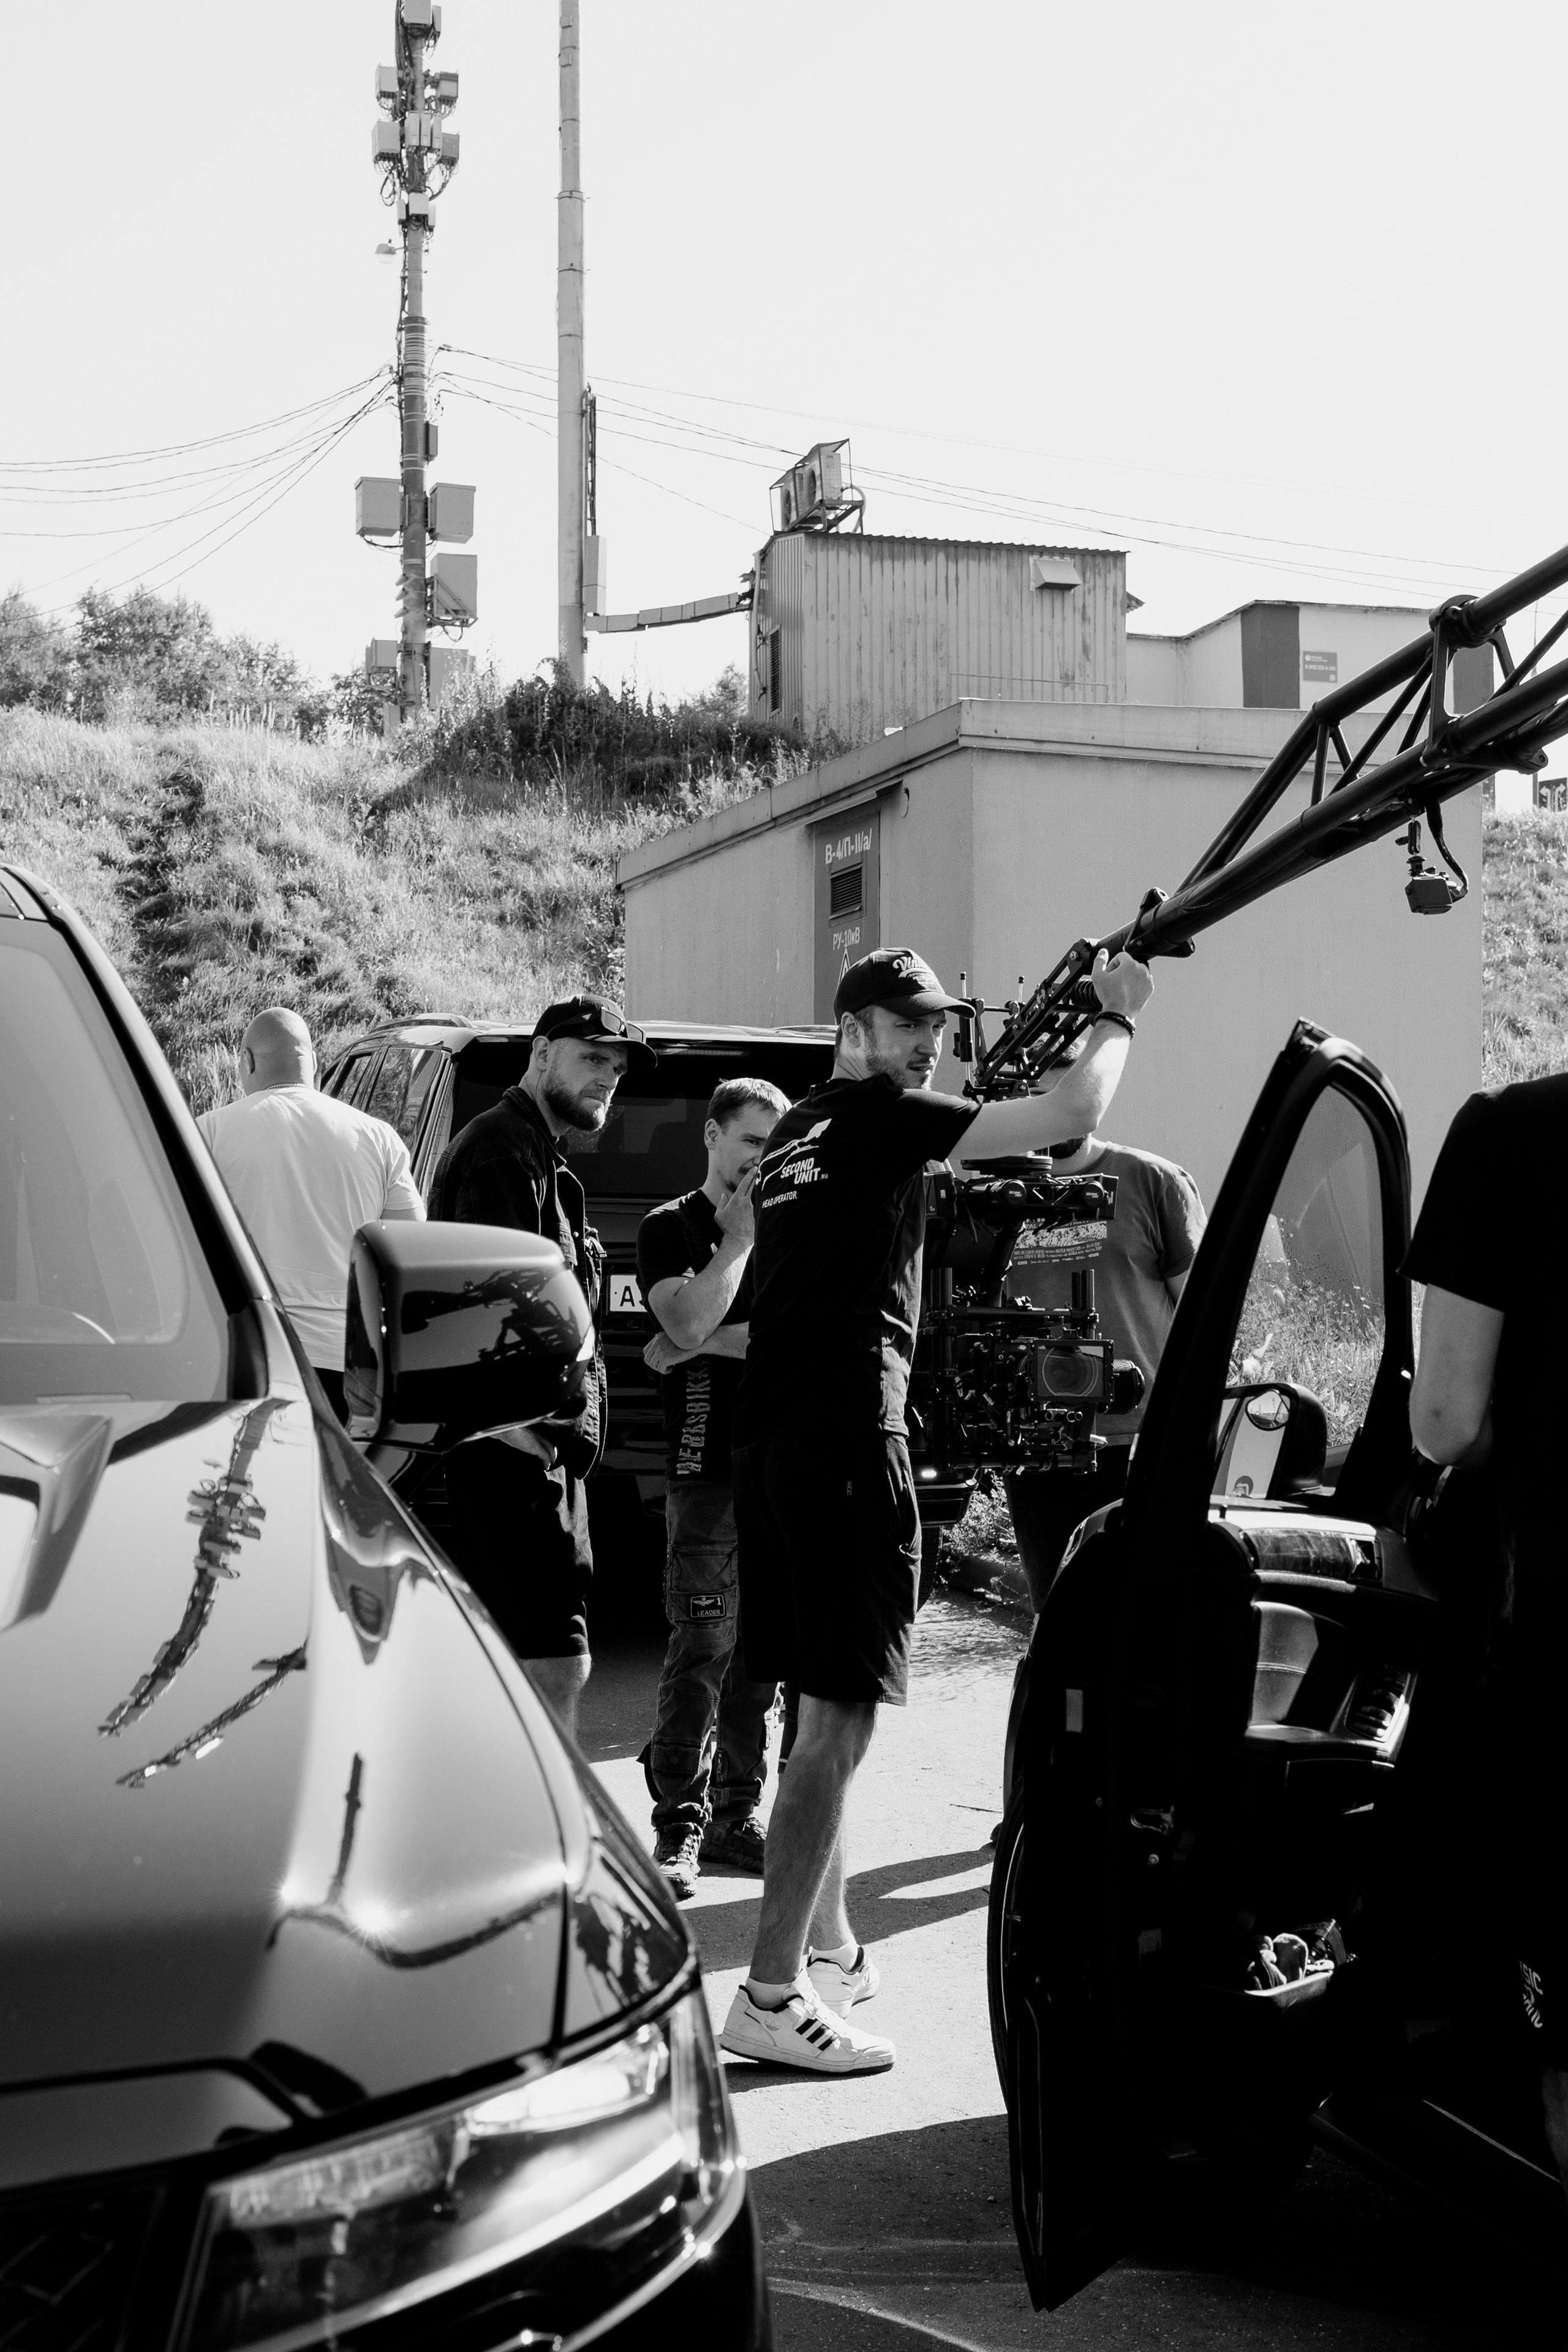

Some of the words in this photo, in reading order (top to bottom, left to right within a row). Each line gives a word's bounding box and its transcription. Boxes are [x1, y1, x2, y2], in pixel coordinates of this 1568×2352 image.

[780, 1157, 815, 1179] SECOND
[762, 1197, 774, 1208] HEAD
[773, 1190, 797, 1205] OPERATOR
[716, 1596, 722, 1605] 1
